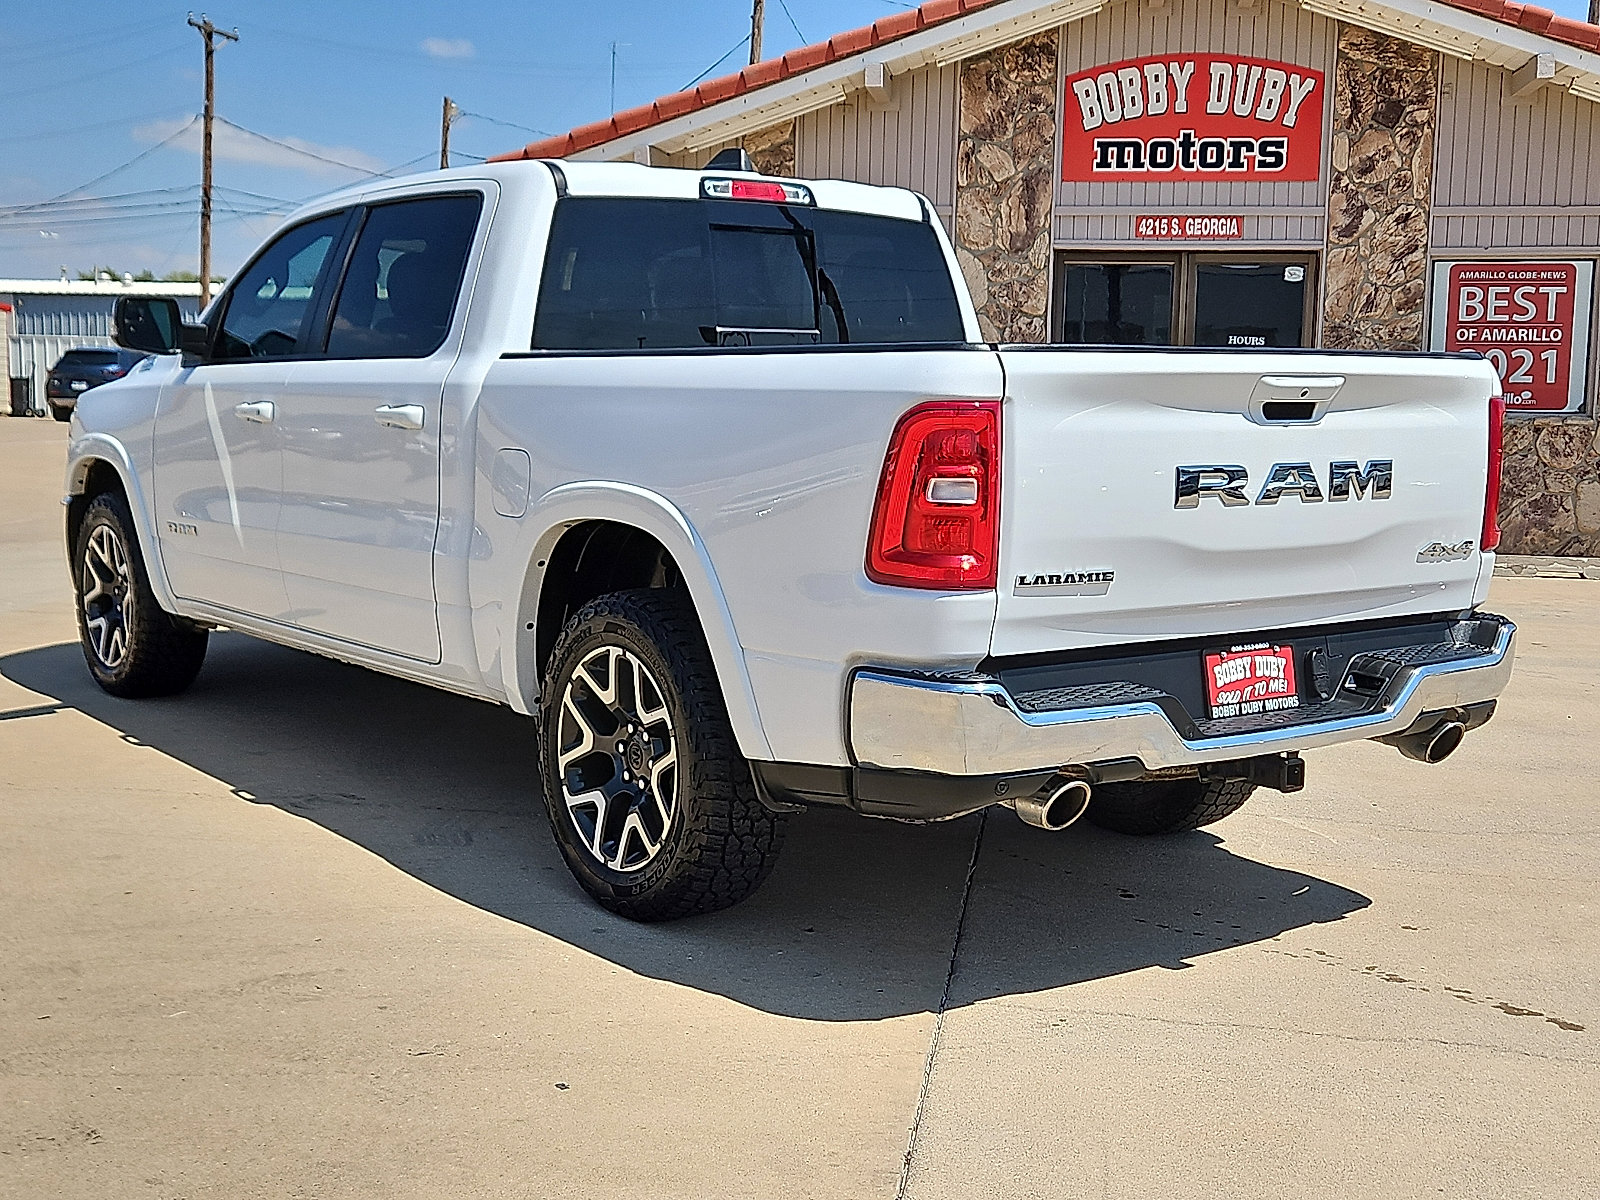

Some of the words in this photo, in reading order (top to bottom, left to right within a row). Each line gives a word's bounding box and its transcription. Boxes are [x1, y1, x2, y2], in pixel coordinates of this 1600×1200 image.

[1072, 61, 1195, 131] BOBBY
[1206, 61, 1316, 128] DUBY
[1092, 129, 1288, 172] motors
[1138, 218, 1168, 236] 4215
[1171, 218, 1182, 236] S.
[1185, 218, 1239, 236] GEORGIA
[1459, 271, 1506, 280] AMARILLO
[1507, 271, 1567, 280] GLOBE-NEWS
[1458, 286, 1568, 322] BEST
[1228, 335, 1266, 346] HOURS
[1456, 328, 1478, 341] OF
[1481, 328, 1562, 342] AMARILLO
[1459, 348, 1558, 384] 021
[1174, 459, 1393, 509] RAM
[1015, 570, 1115, 586] LARAMIE
[1213, 656, 1252, 689] BOBBY
[1254, 655, 1287, 679] DUBY
[1216, 690, 1241, 704] SOLD
[1242, 685, 1254, 702] IT
[1254, 680, 1267, 697] TO
[1268, 678, 1288, 693] ME!
[1212, 703, 1240, 719] BOBBY
[1241, 700, 1264, 715] DUBY
[1265, 695, 1300, 711] MOTORS
[631, 841, 677, 896] COOPER
